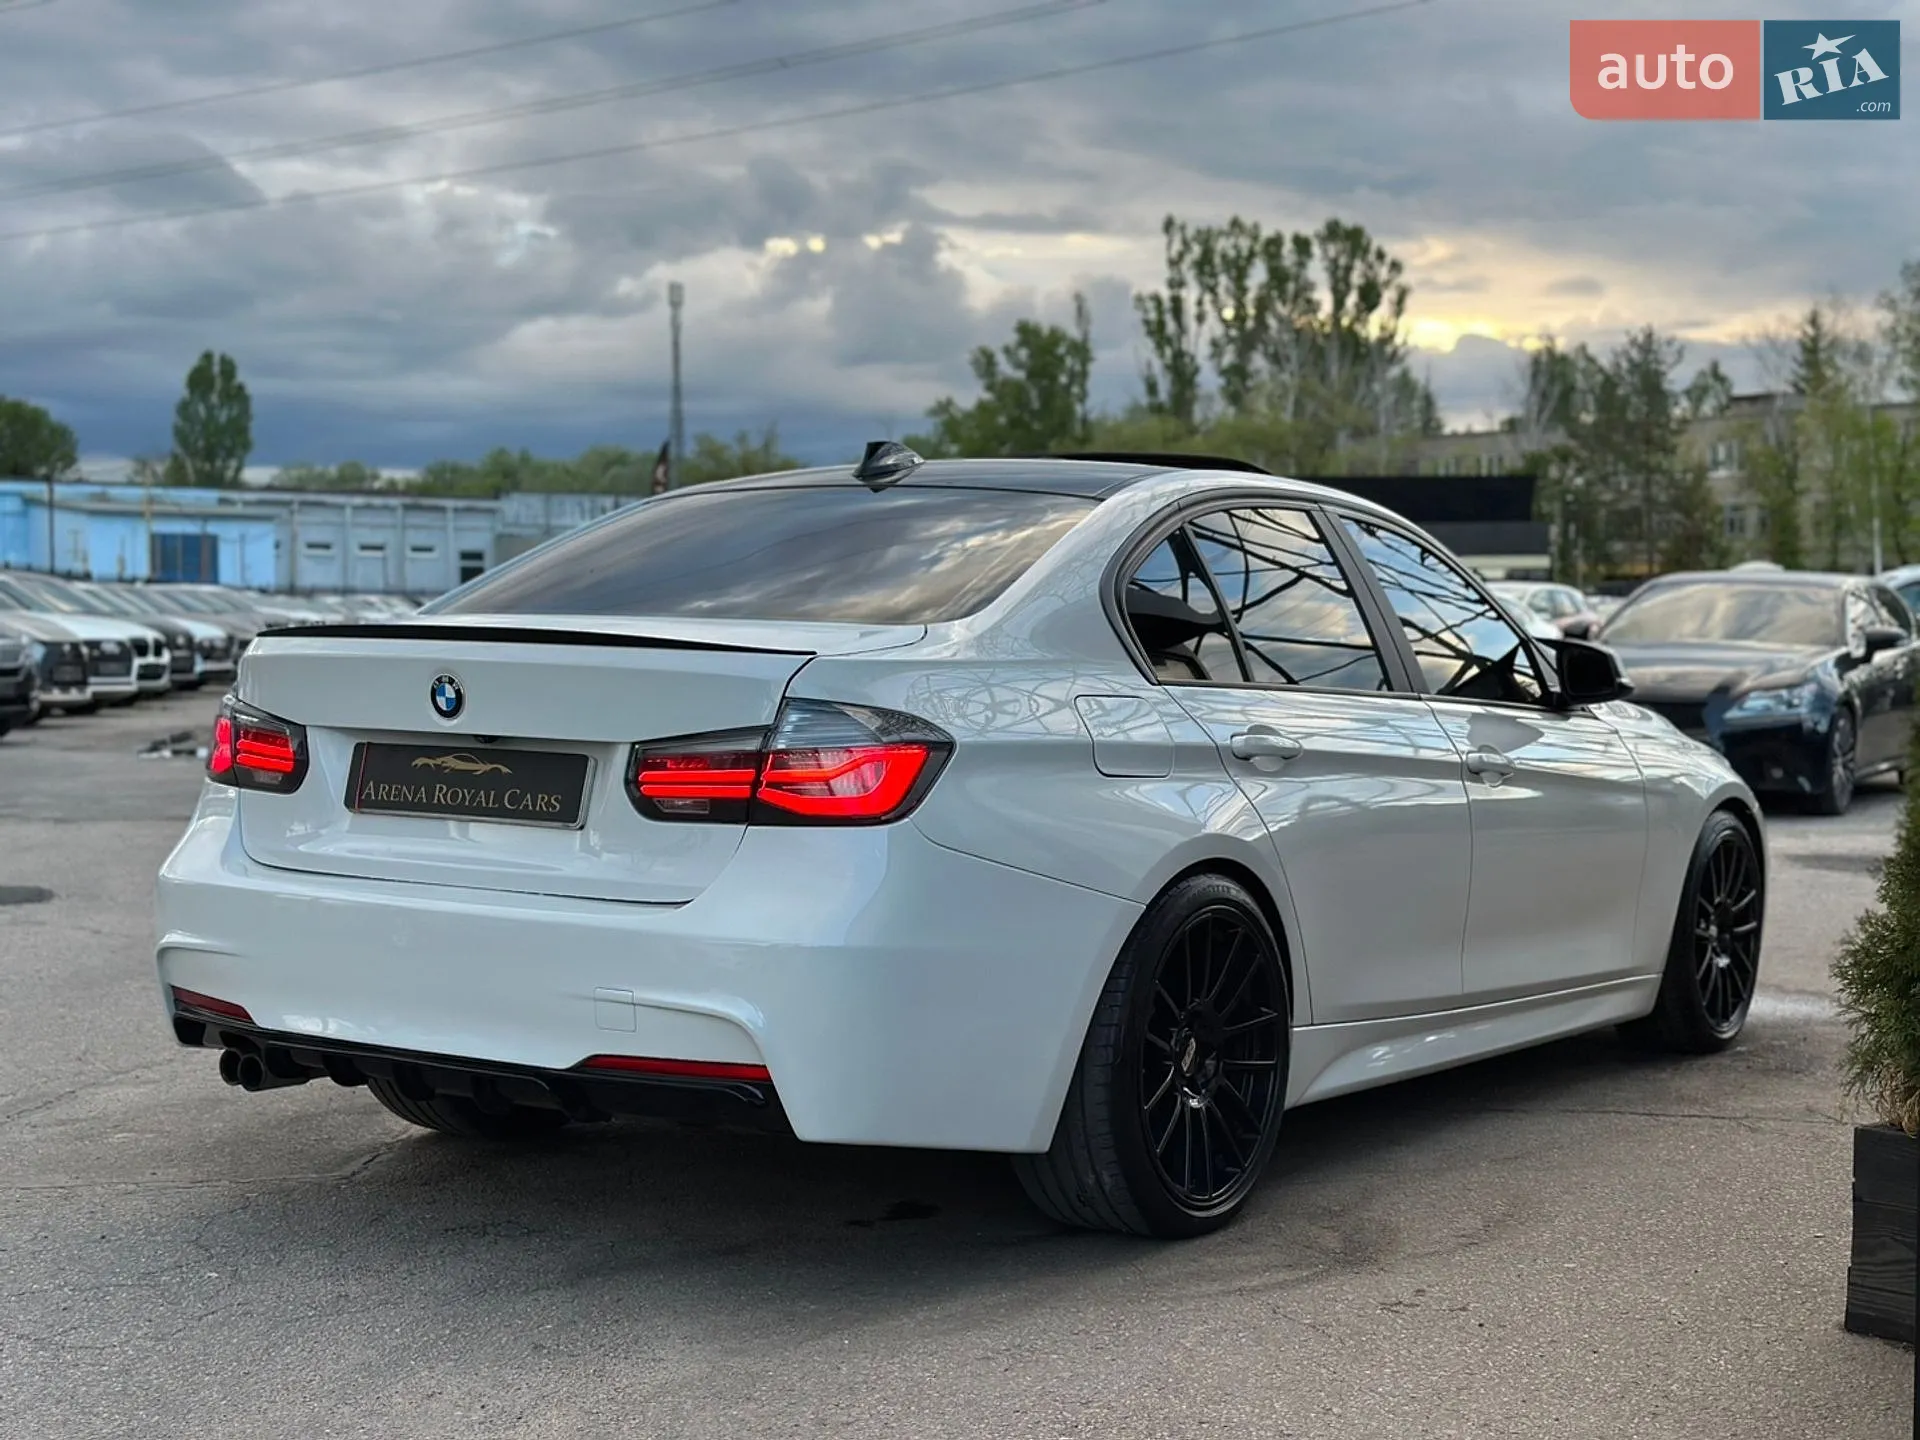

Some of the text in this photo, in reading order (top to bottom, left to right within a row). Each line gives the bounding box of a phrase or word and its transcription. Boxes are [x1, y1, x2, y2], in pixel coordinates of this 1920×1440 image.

[361, 780, 562, 812] ARENA ROYAL CARS
